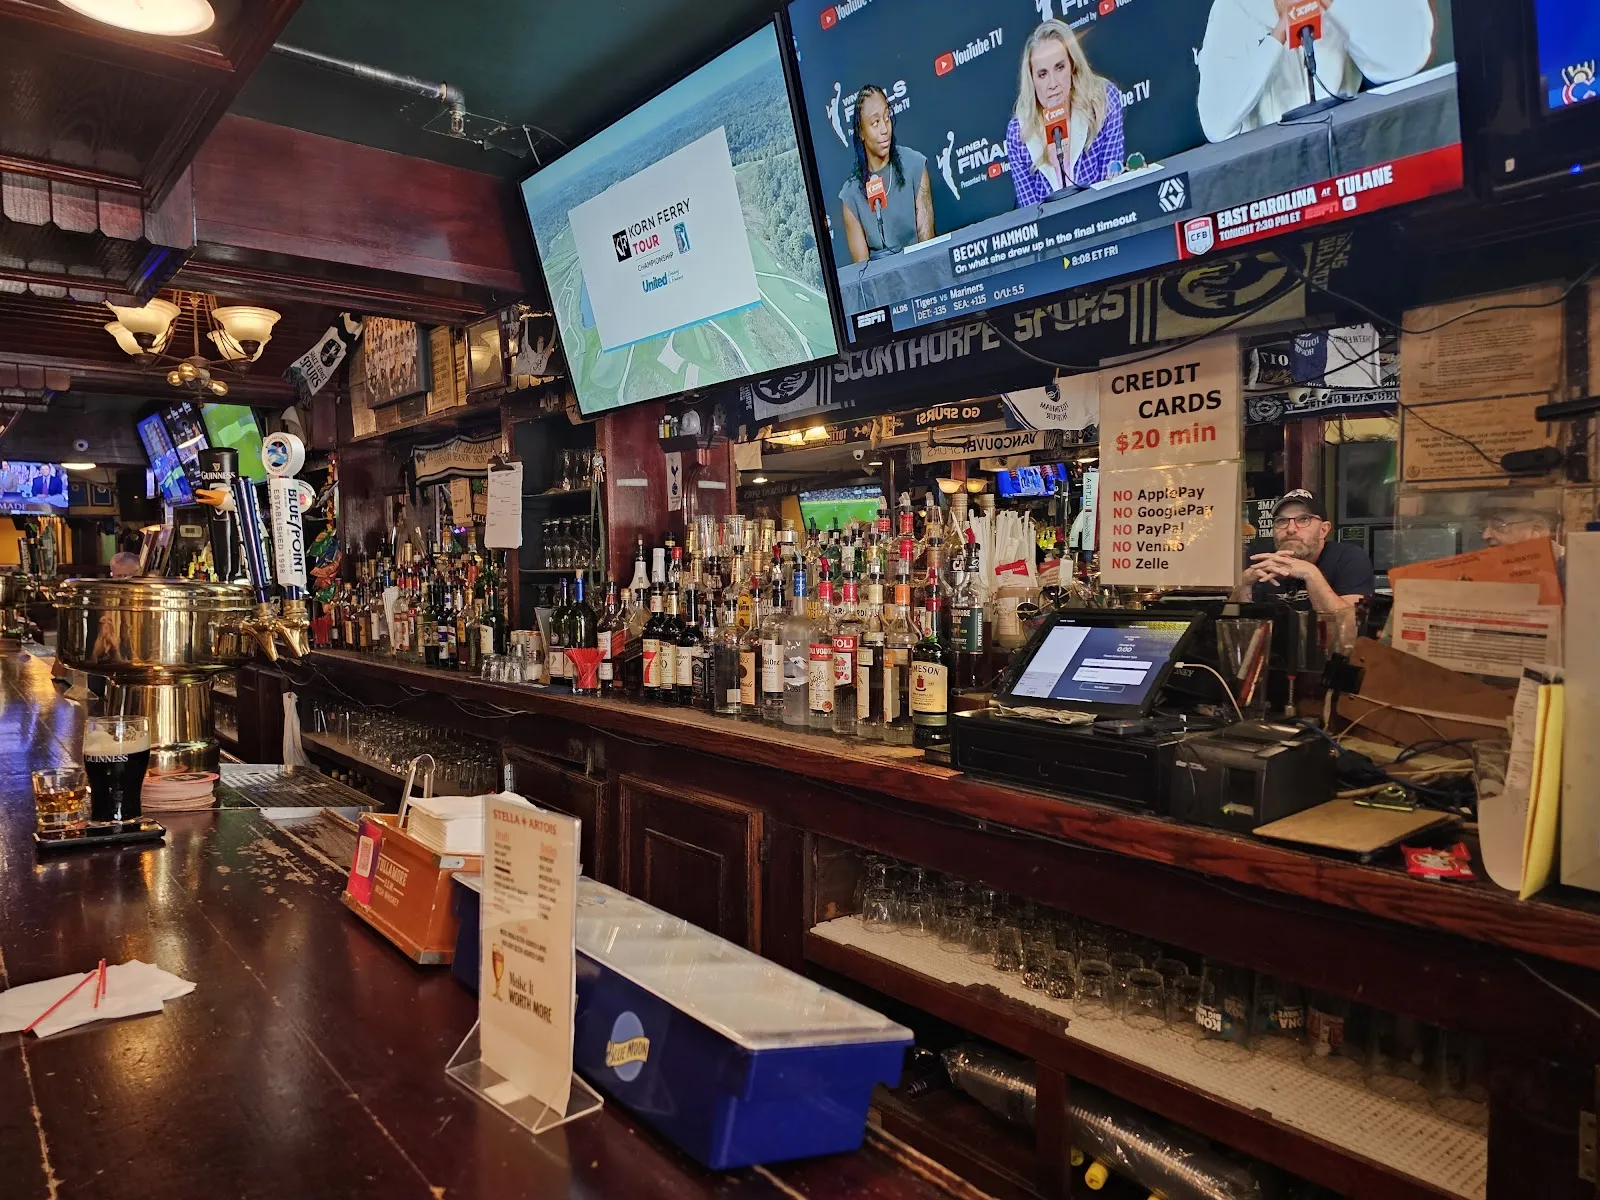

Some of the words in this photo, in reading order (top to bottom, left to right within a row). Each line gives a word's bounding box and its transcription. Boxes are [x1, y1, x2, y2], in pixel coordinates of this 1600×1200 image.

[953, 35, 990, 67] YouTube
[987, 27, 1003, 50] TV
[1133, 80, 1150, 102] TV
[956, 138, 989, 157] WNBA
[1217, 205, 1248, 229] EAST
[1250, 186, 1317, 220] CAROLINA
[1321, 187, 1332, 198] AT
[1336, 165, 1394, 197] TULANE
[628, 215, 656, 238] KORN
[657, 198, 690, 226] FERRY
[1219, 225, 1254, 241] TONIGHT
[1256, 220, 1274, 233] 7:30
[1275, 216, 1289, 228] PM
[1289, 213, 1301, 224] ET
[633, 234, 660, 255] TOUR
[953, 239, 988, 263] BECKY
[991, 223, 1039, 249] HAMMON
[955, 263, 967, 273] On
[968, 257, 990, 271] what
[990, 251, 1006, 263] she
[1007, 245, 1031, 261] drew
[1032, 242, 1044, 254] up
[1045, 237, 1053, 248] in
[1055, 232, 1071, 245] the
[1073, 225, 1095, 240] final
[1096, 211, 1137, 233] timeout
[637, 252, 674, 272] CHAMPIONSHIP
[1071, 253, 1091, 267] 8:08
[1091, 249, 1103, 261] ET
[1104, 245, 1119, 258] FRI
[642, 272, 668, 293] United
[915, 295, 938, 309] Tigers
[939, 293, 948, 301] vs
[950, 283, 984, 299] Mariners
[917, 310, 932, 320] DET:
[953, 301, 970, 311] SEA:
[994, 288, 1011, 300] O/U:
[1012, 284, 1025, 295] 5.5
[857, 310, 886, 328] ESPN
[892, 304, 908, 315] ALDS
[300, 355, 322, 388] SPURS
[1111, 363, 1200, 394] CREDIT
[1138, 390, 1222, 419] CARDS
[1116, 428, 1160, 455] $20
[1170, 423, 1216, 446] min
[201, 471, 236, 481] GUINNESS
[1113, 490, 1133, 502] NO
[1138, 486, 1204, 503] ApplePay
[273, 489, 284, 549] ESTABLISHED
[1113, 507, 1133, 519] NO
[1138, 504, 1214, 520] GooglePay
[1113, 524, 1132, 535] NO
[1137, 521, 1184, 538] PayPal
[1113, 541, 1131, 552] NO
[1137, 541, 1185, 553] Venmo
[277, 552, 286, 574] 1998
[1112, 558, 1131, 569] NO
[1136, 557, 1169, 569] Zelle
[834, 639, 853, 648] TOLI
[85, 754, 129, 763] GUINNESS
[493, 808, 521, 826] STELLA
[528, 819, 557, 836] ARTOIS
[508, 988, 531, 1012] WORTH
[532, 1003, 553, 1025] MORE
[1195, 1015, 1222, 1031] KON
